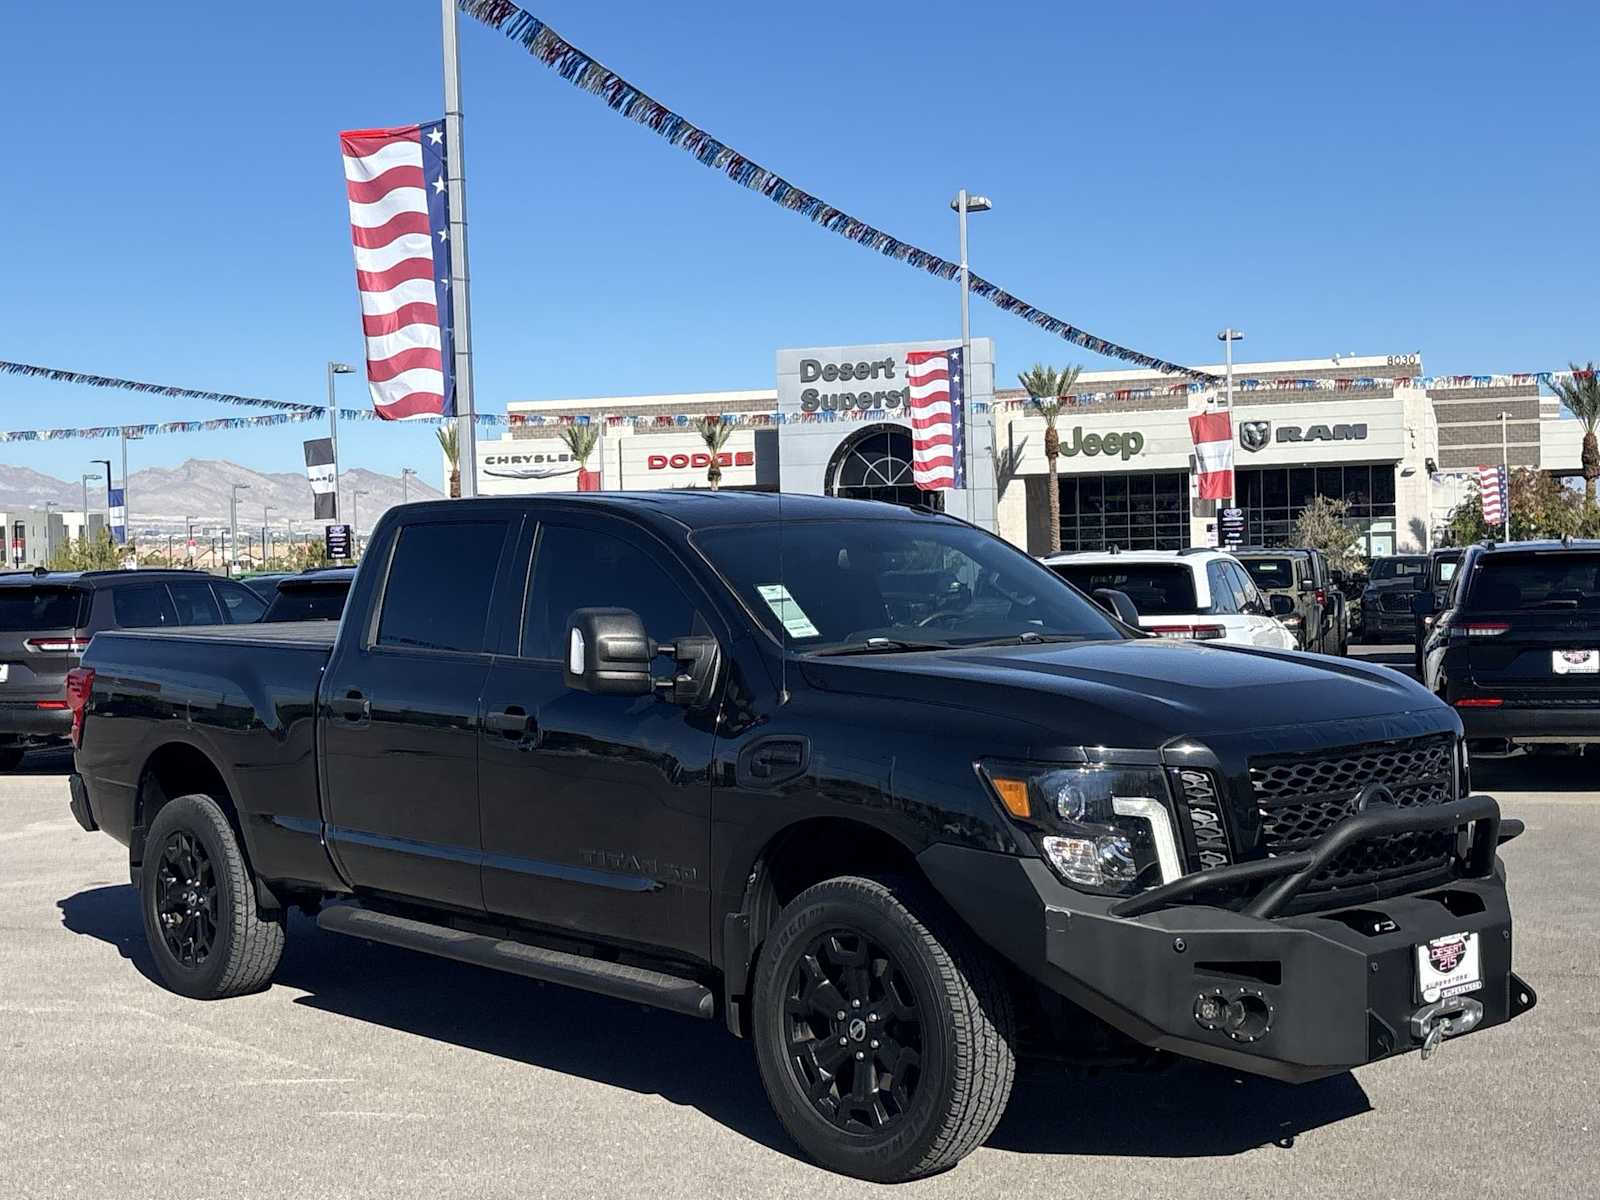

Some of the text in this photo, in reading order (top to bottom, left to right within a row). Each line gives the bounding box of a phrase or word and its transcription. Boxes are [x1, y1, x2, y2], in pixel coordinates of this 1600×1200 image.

[1387, 355, 1416, 366] 8030
[800, 357, 896, 384] Desert
[1276, 423, 1368, 443] RAM
[1059, 427, 1144, 461] Jeep
[648, 451, 755, 470] DODGE
[1431, 943, 1463, 959] DESERT
